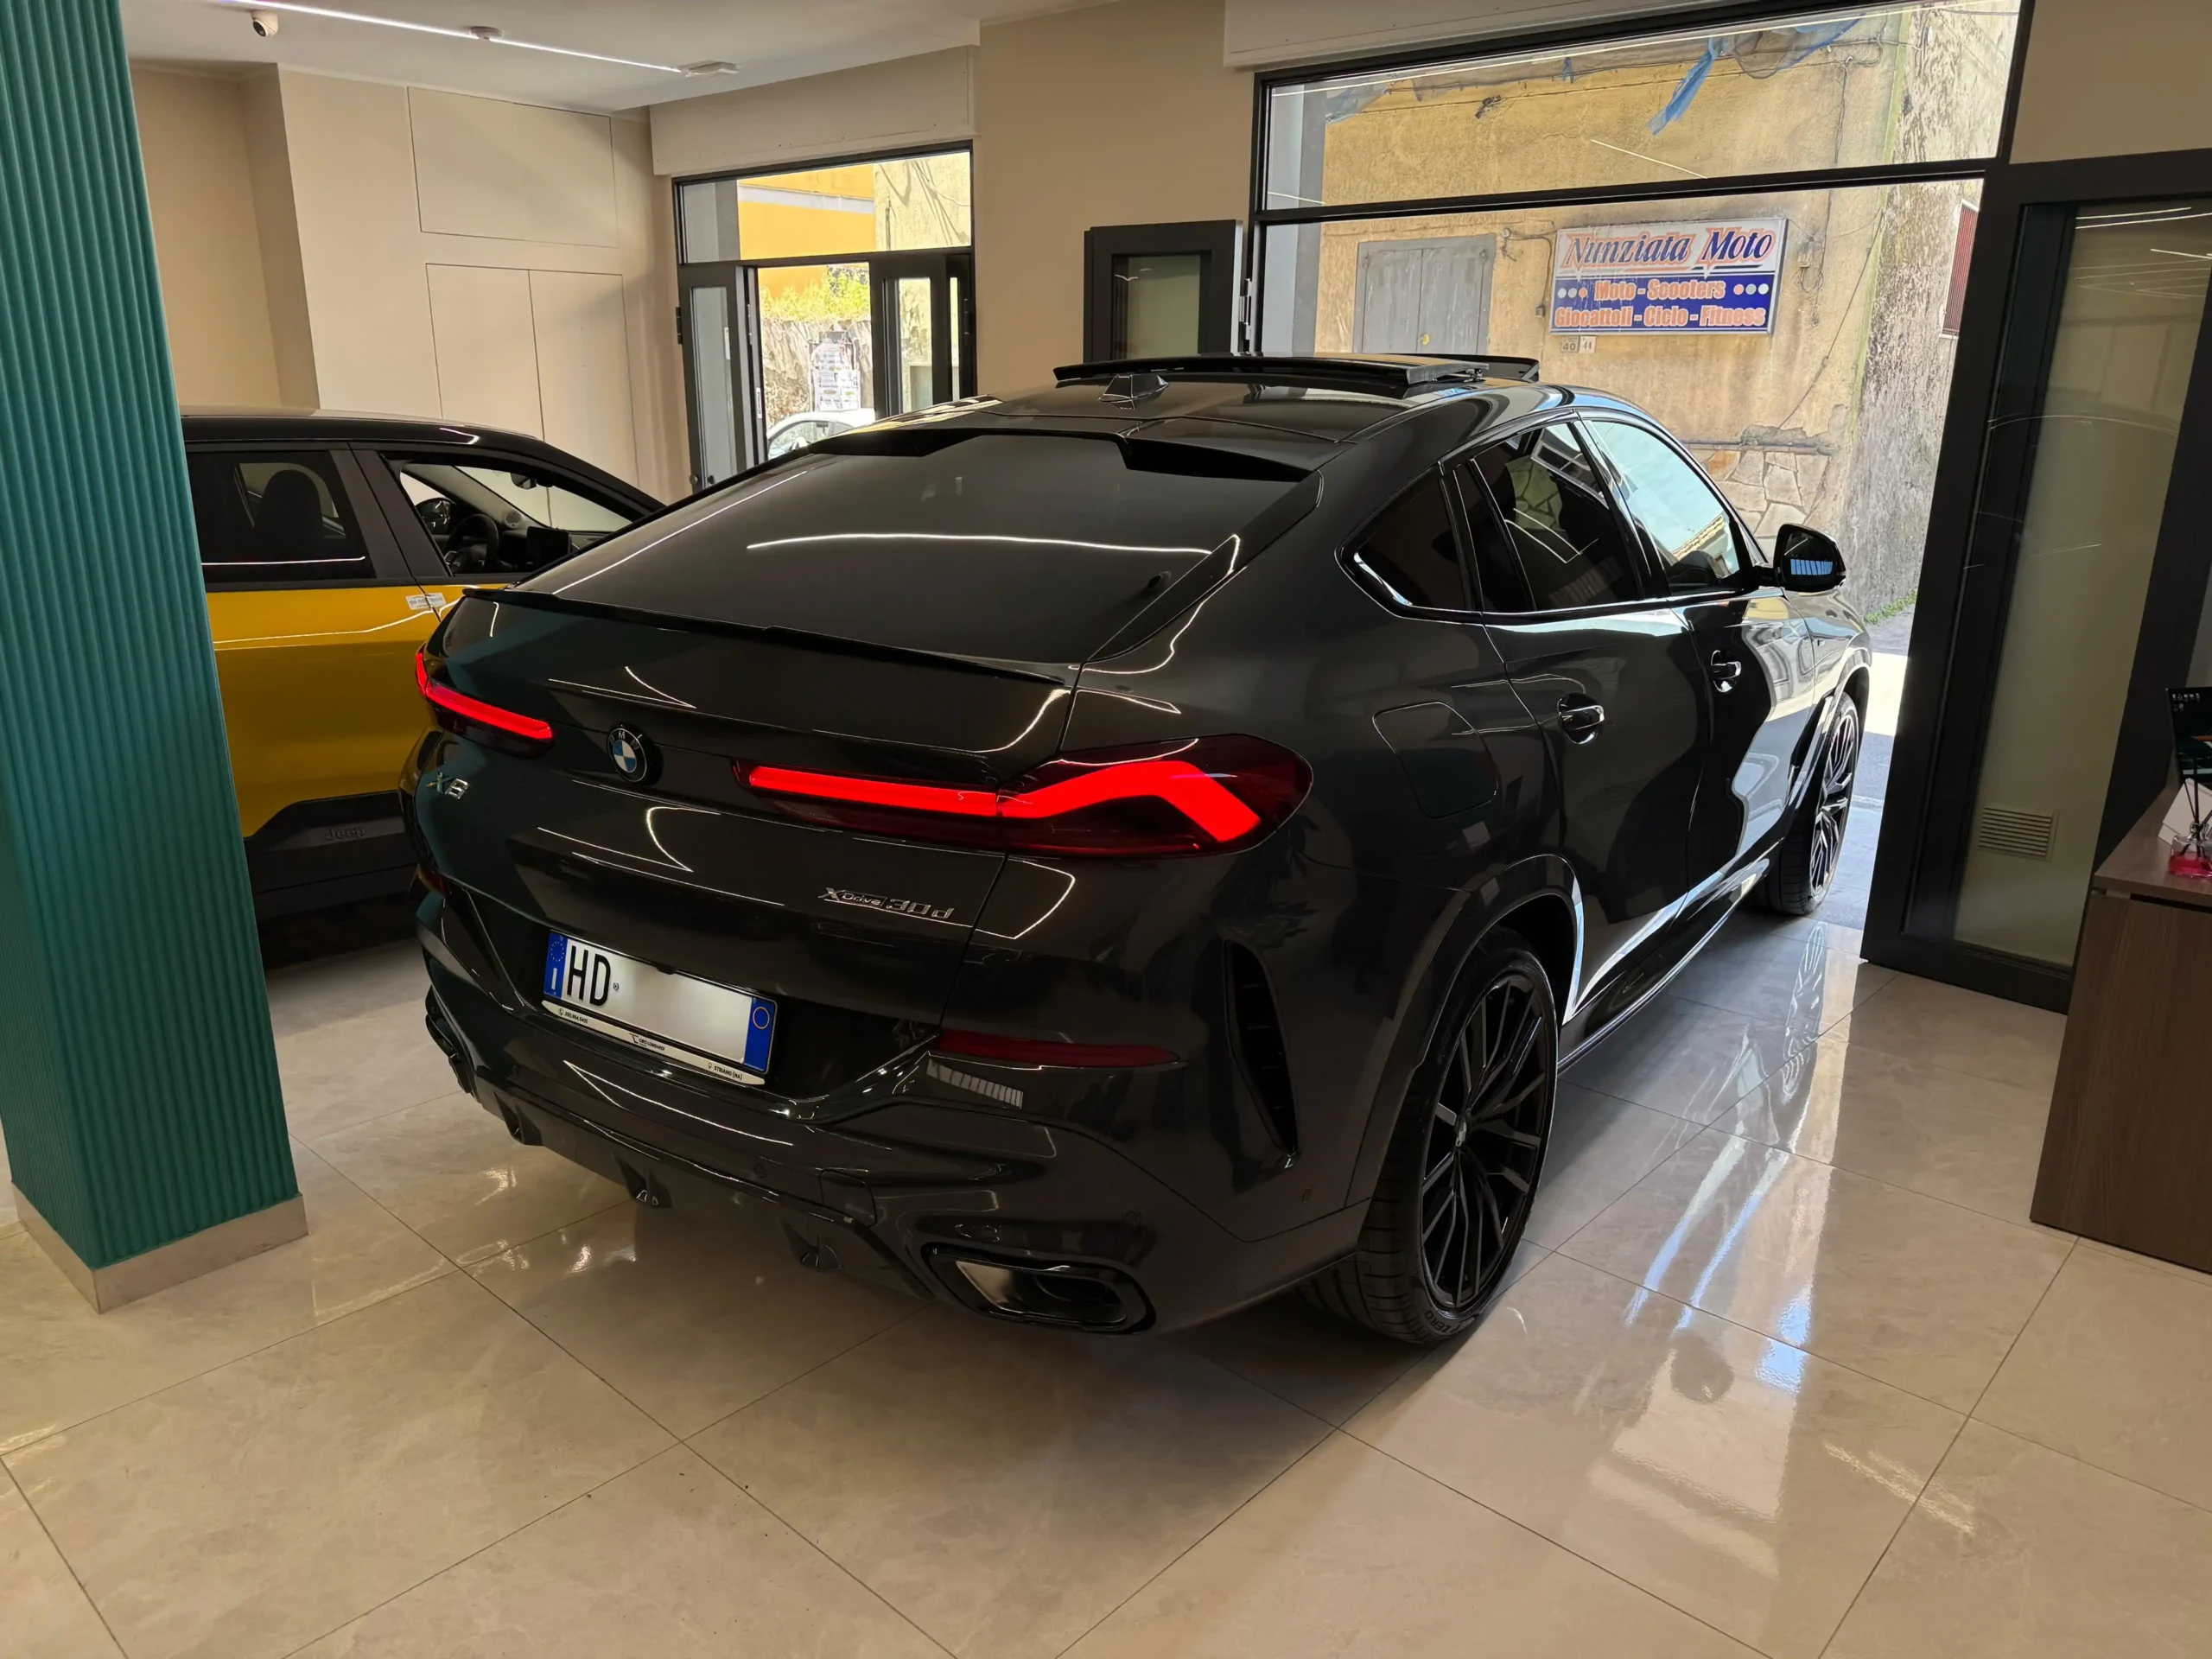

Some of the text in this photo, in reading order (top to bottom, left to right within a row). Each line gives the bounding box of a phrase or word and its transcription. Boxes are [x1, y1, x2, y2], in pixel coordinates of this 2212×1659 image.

[1562, 228, 1774, 268] Nunziata Moto
[1593, 281, 1637, 301] Moto
[1647, 278, 1726, 300] Scooters
[1554, 306, 1634, 327] Giocattoli
[1643, 306, 1688, 327] Ciclo
[1699, 304, 1766, 327] Fitness
[1562, 342, 1576, 351] 40
[609, 729, 639, 750] BMW
[426, 771, 470, 799] X6
[324, 826, 365, 842] Jeep
[714, 1065, 733, 1076] STRIANO
[1424, 1310, 1452, 1333] ZERO
